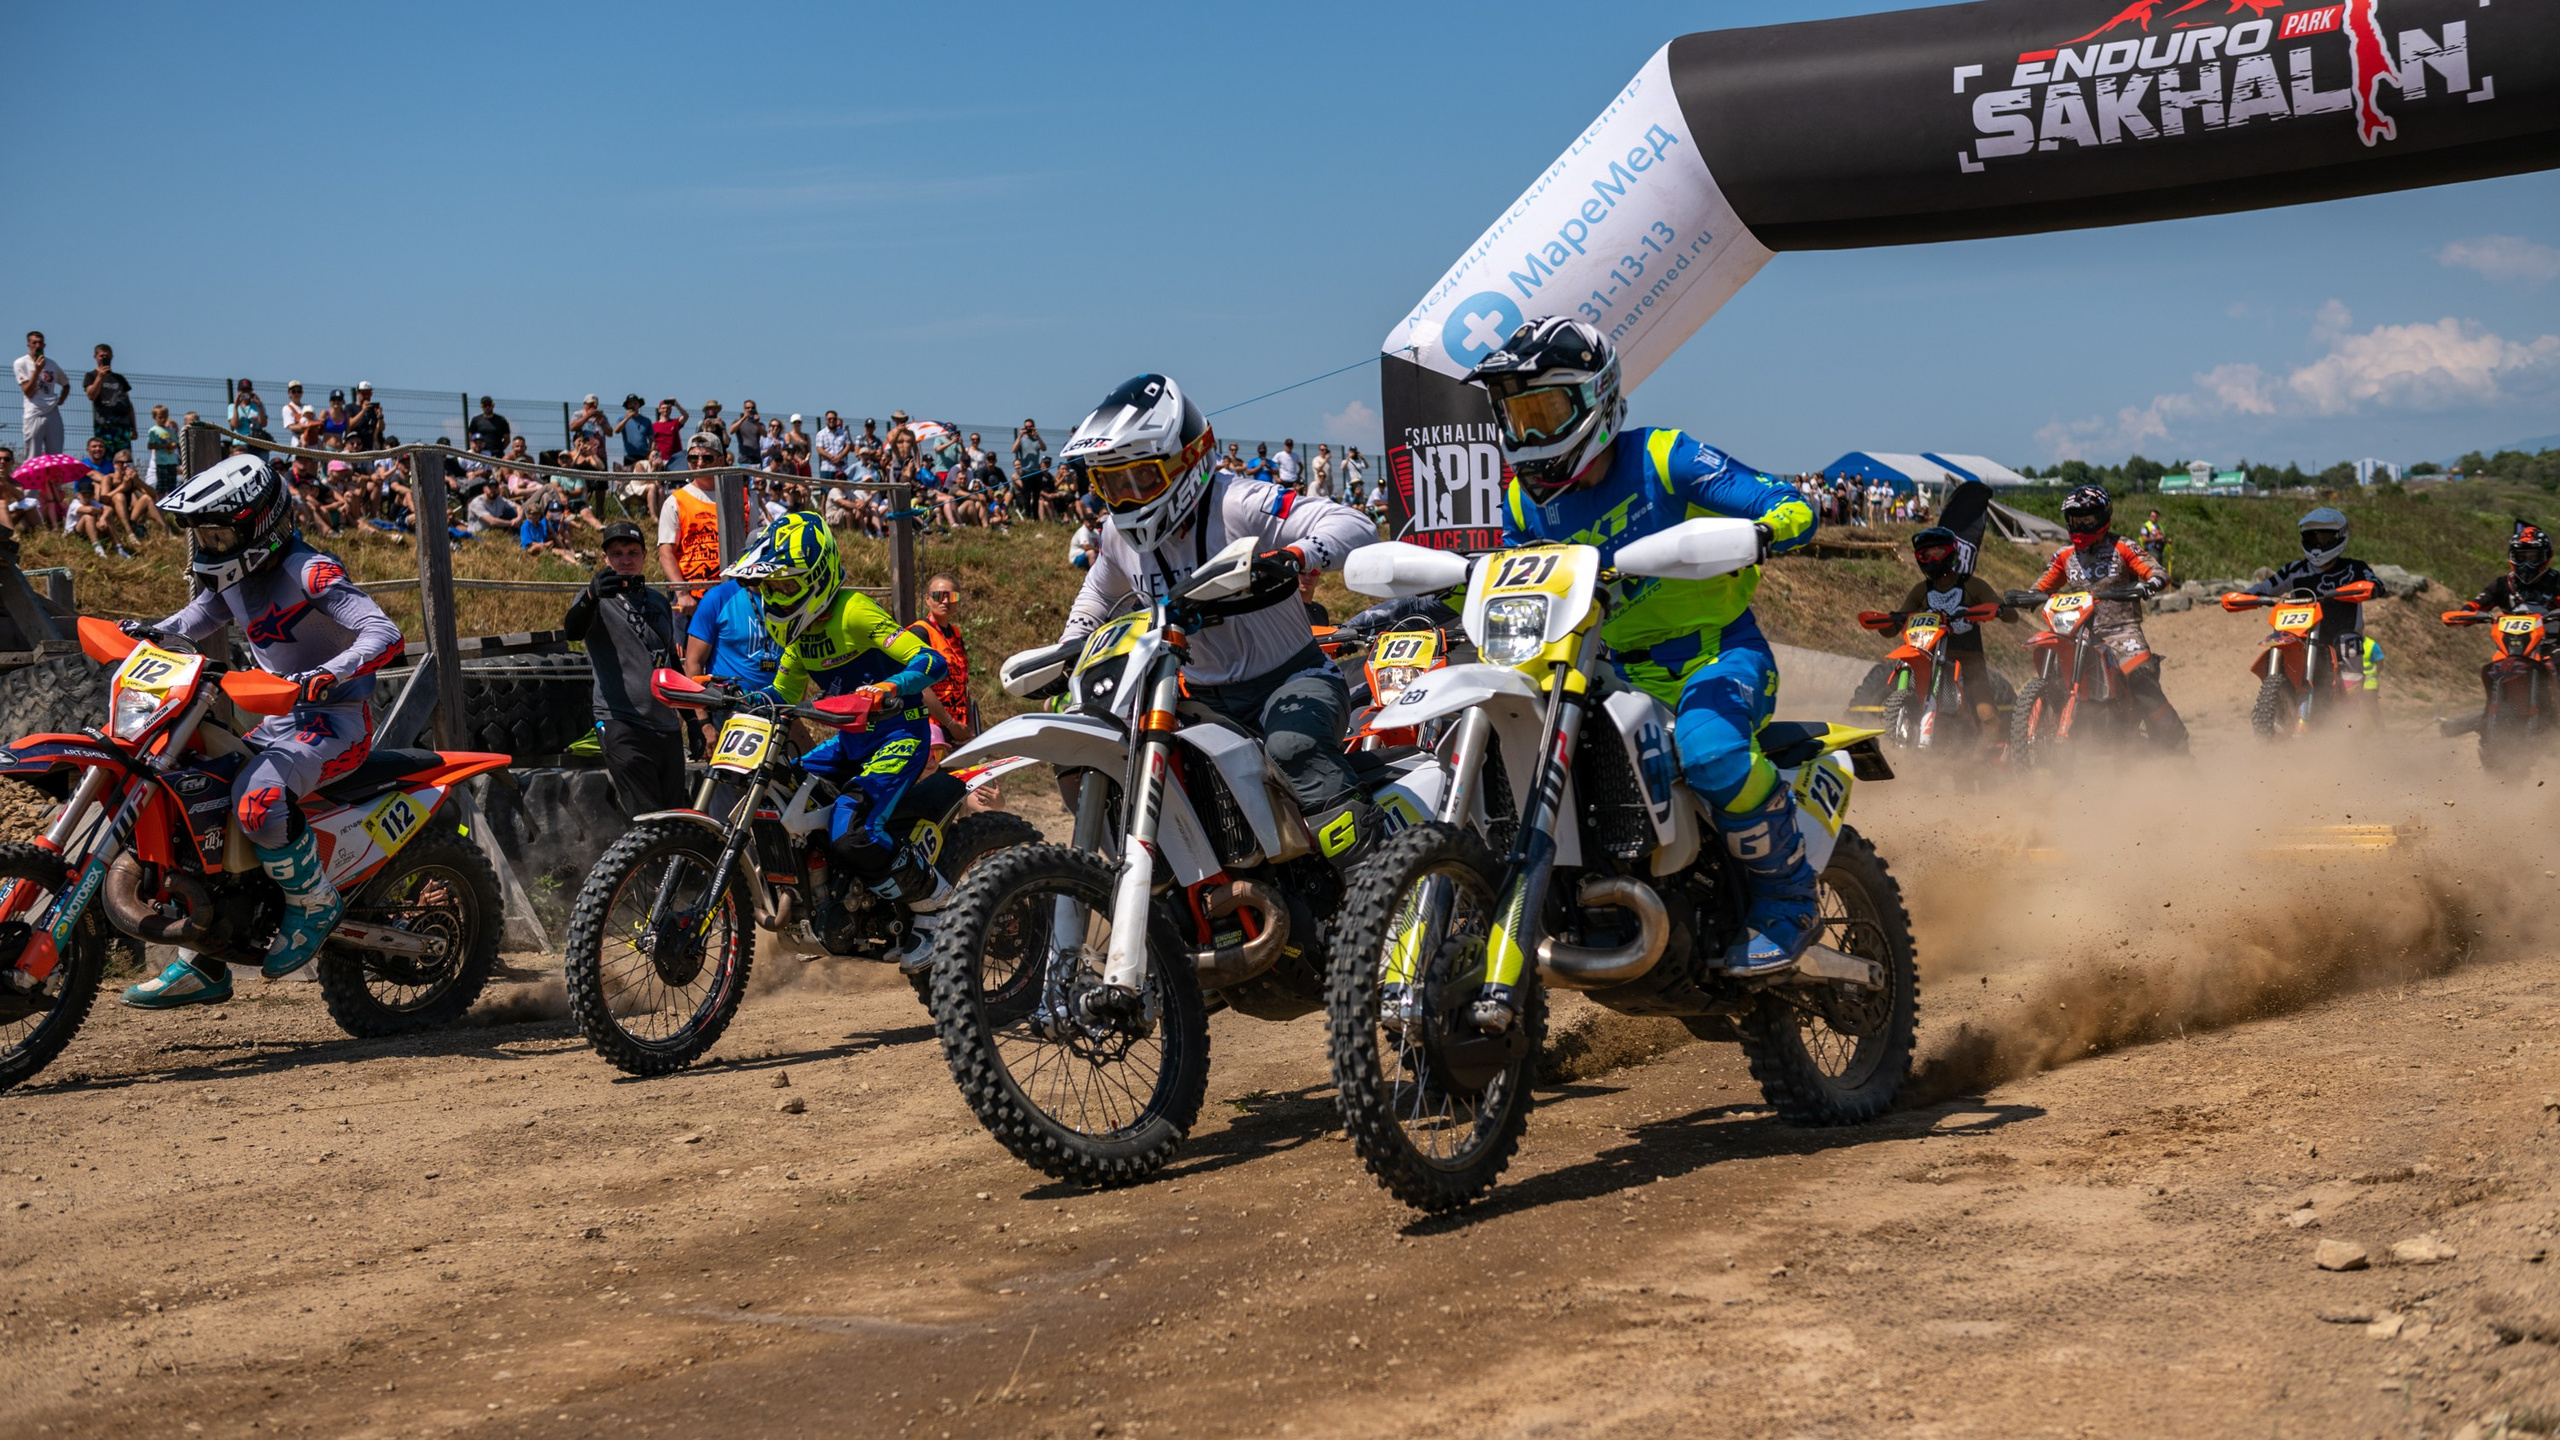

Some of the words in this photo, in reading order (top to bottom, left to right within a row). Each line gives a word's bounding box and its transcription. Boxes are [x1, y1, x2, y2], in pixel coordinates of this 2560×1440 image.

[2011, 20, 2273, 87] ENDURO
[2284, 9, 2337, 36] PARK
[1507, 123, 1680, 299] МареМед
[1407, 160, 1568, 330] Медицинский
[1578, 220, 1676, 325] 31-13-13
[1609, 230, 1714, 342] maremed.ru
[1413, 423, 1497, 446] SAKHALIN
[1418, 530, 1462, 550] PLACE
[1466, 529, 1488, 550] TO
[1493, 555, 1560, 588] 121
[1911, 617, 1937, 628] 105
[2281, 613, 2309, 625] 123
[2504, 621, 2532, 632] 146
[799, 637, 837, 660] MOTO
[1084, 622, 1133, 662] 101
[1382, 639, 1423, 660] 191
[128, 658, 172, 684] 112
[762, 660, 776, 669] STAFF
[717, 730, 764, 757] 106
[1810, 764, 1845, 820] 121
[381, 800, 416, 842] 112
[63, 867, 103, 923] MOTOREX
